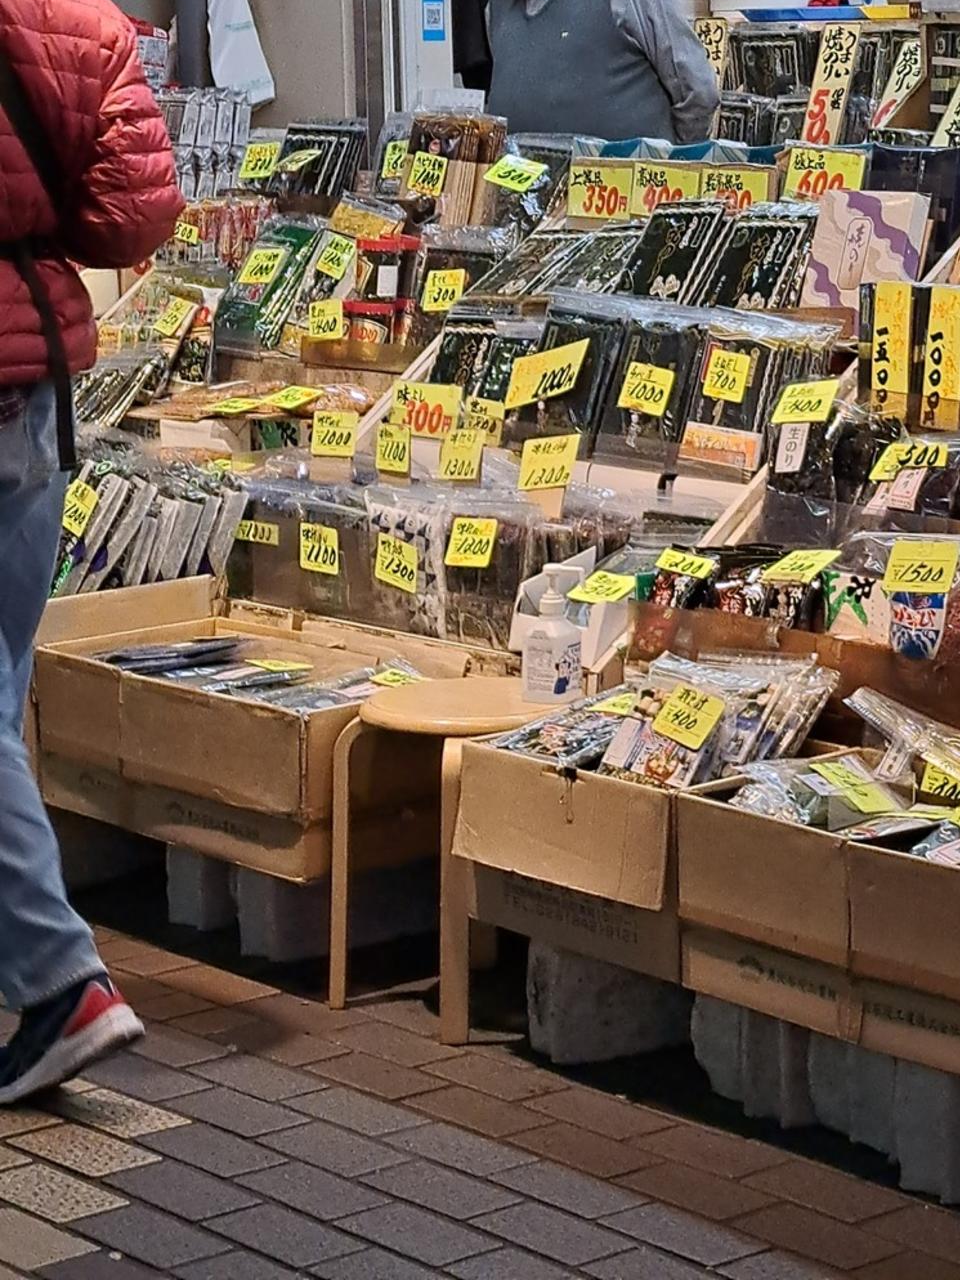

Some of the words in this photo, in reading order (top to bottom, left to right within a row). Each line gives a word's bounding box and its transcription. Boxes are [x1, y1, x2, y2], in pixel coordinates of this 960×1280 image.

[497, 168, 532, 185] 500
[581, 186, 628, 216] 350円
[629, 380, 665, 404] 1000
[715, 371, 737, 391] 900
[403, 401, 453, 434] 300円
[784, 427, 801, 467] 生のり
[897, 444, 940, 466] 500
[385, 557, 416, 582] 1300
[899, 562, 944, 583] 1500
[671, 709, 699, 731] 400
